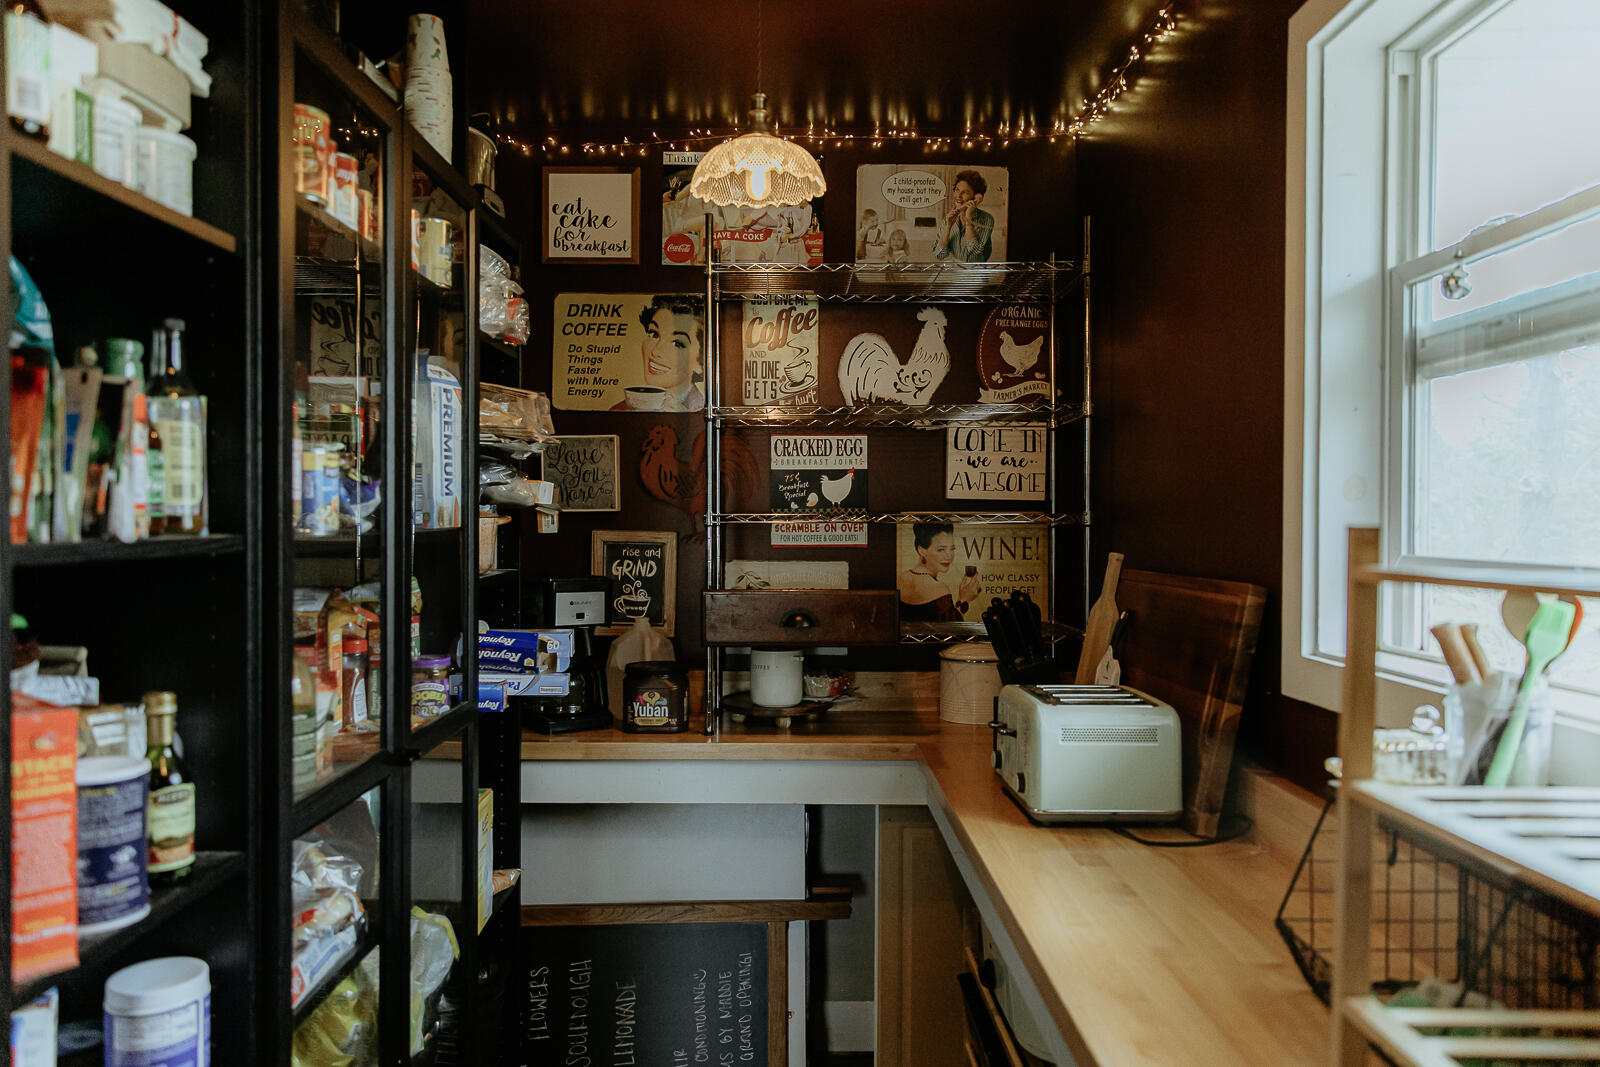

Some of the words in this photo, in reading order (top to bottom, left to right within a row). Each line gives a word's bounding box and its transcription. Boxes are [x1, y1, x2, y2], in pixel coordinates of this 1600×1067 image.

[887, 187, 896, 196] my
[897, 186, 915, 194] house
[928, 187, 942, 197] they
[552, 197, 588, 216] eat
[911, 196, 922, 205] get
[559, 209, 618, 229] cake
[553, 226, 590, 248] for
[561, 239, 631, 255] breakfast
[567, 303, 624, 317] DRINK
[1001, 305, 1042, 319] ORGANIC
[561, 322, 628, 336] COFFEE
[745, 306, 818, 351] Coffee
[1033, 320, 1048, 329] EGGS
[568, 344, 582, 353] Do
[586, 344, 621, 355] Stupid
[749, 350, 767, 358] AND
[567, 355, 603, 365] Things
[567, 366, 601, 375] Faster
[744, 360, 757, 379] NO
[761, 360, 780, 379] ONE
[567, 376, 589, 385] with
[592, 376, 619, 385] More
[567, 386, 605, 398] Energy
[744, 380, 777, 399] GETS
[993, 388, 1022, 400] FARMER'S
[1023, 383, 1048, 393] MARKET
[795, 389, 818, 405] hurt
[442, 387, 454, 497] PREMIUM
[954, 427, 1013, 452] COME
[1019, 429, 1042, 452] IN
[774, 438, 833, 457] CRACKED
[836, 438, 863, 457] EGG
[546, 442, 604, 475] Love
[780, 458, 828, 466] BREAKFAST
[833, 458, 858, 466] JOINT
[966, 455, 991, 468] we
[1000, 455, 1028, 468] are
[563, 462, 605, 488] You
[949, 471, 1045, 492] AWESOME
[778, 480, 809, 492] Breakfast
[559, 484, 600, 507] More
[783, 489, 807, 501] Special
[774, 521, 820, 532] SCRAMBLE
[823, 522, 837, 532] ON
[840, 522, 864, 532] OVER
[828, 534, 844, 542] GOOD
[845, 534, 859, 542] EATS!
[622, 547, 640, 557] rise
[644, 547, 661, 559] and
[961, 536, 1040, 560] WINE!
[611, 559, 657, 581] GRIND
[981, 574, 1005, 582] HOW
[1007, 574, 1040, 582] CLASSY
[985, 586, 1016, 594] PEOPLE
[1020, 586, 1036, 594] GET
[479, 635, 516, 646] Reynol
[633, 702, 669, 717] Yuban
